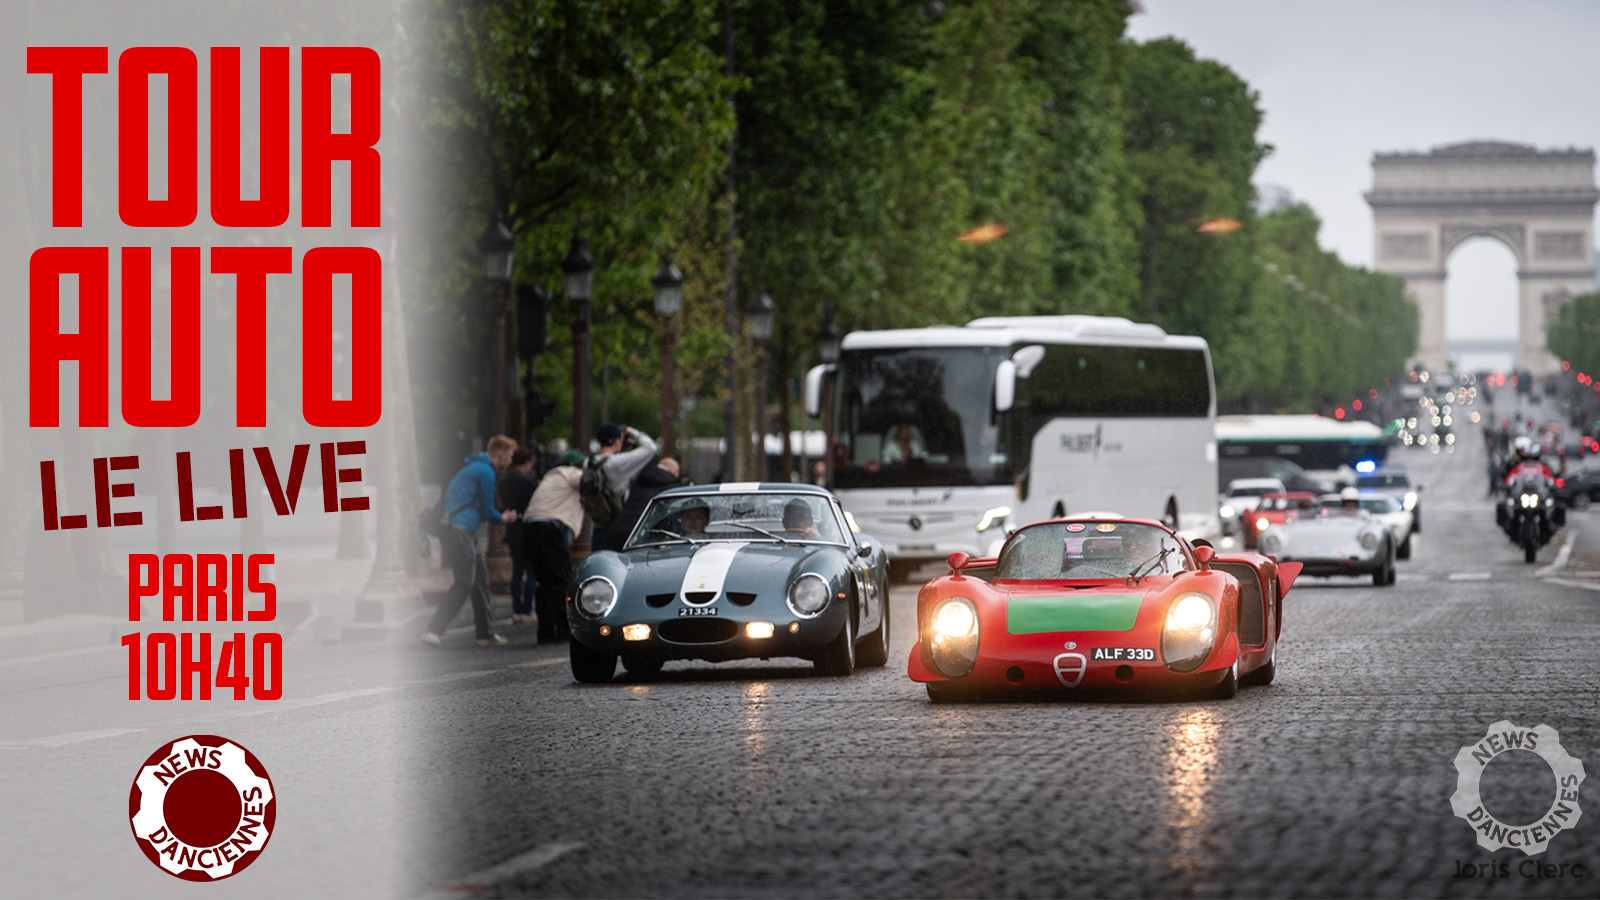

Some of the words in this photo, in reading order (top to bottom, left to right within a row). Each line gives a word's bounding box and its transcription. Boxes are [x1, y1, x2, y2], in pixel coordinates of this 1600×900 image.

[680, 608, 716, 616] 21334
[1094, 648, 1123, 659] ALF
[1127, 648, 1154, 660] 33D
